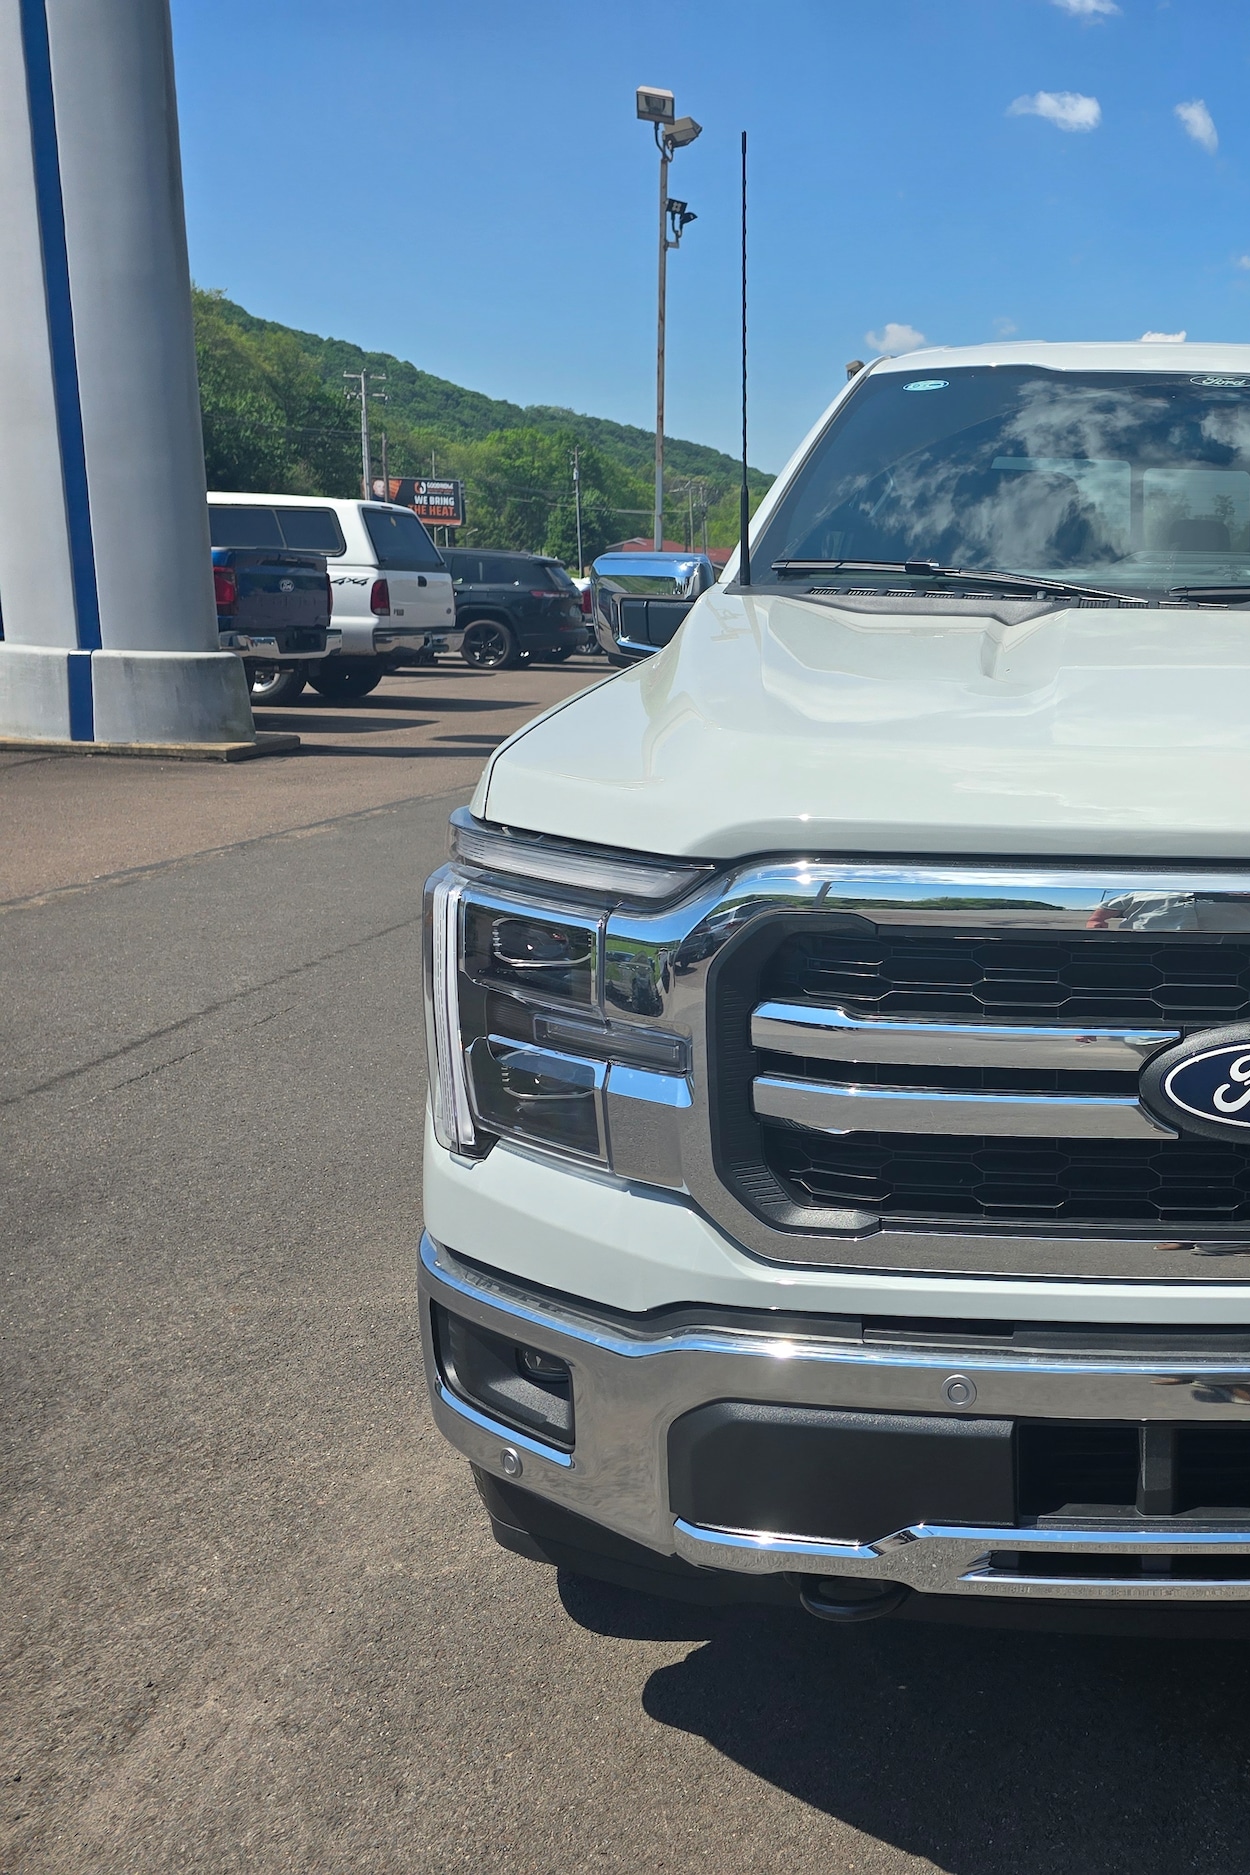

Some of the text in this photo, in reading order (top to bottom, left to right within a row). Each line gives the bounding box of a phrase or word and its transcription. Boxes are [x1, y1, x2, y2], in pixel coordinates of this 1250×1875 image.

[1202, 376, 1246, 386] Ford
[414, 495, 455, 506] WE BRING
[429, 505, 457, 517] HEAT.
